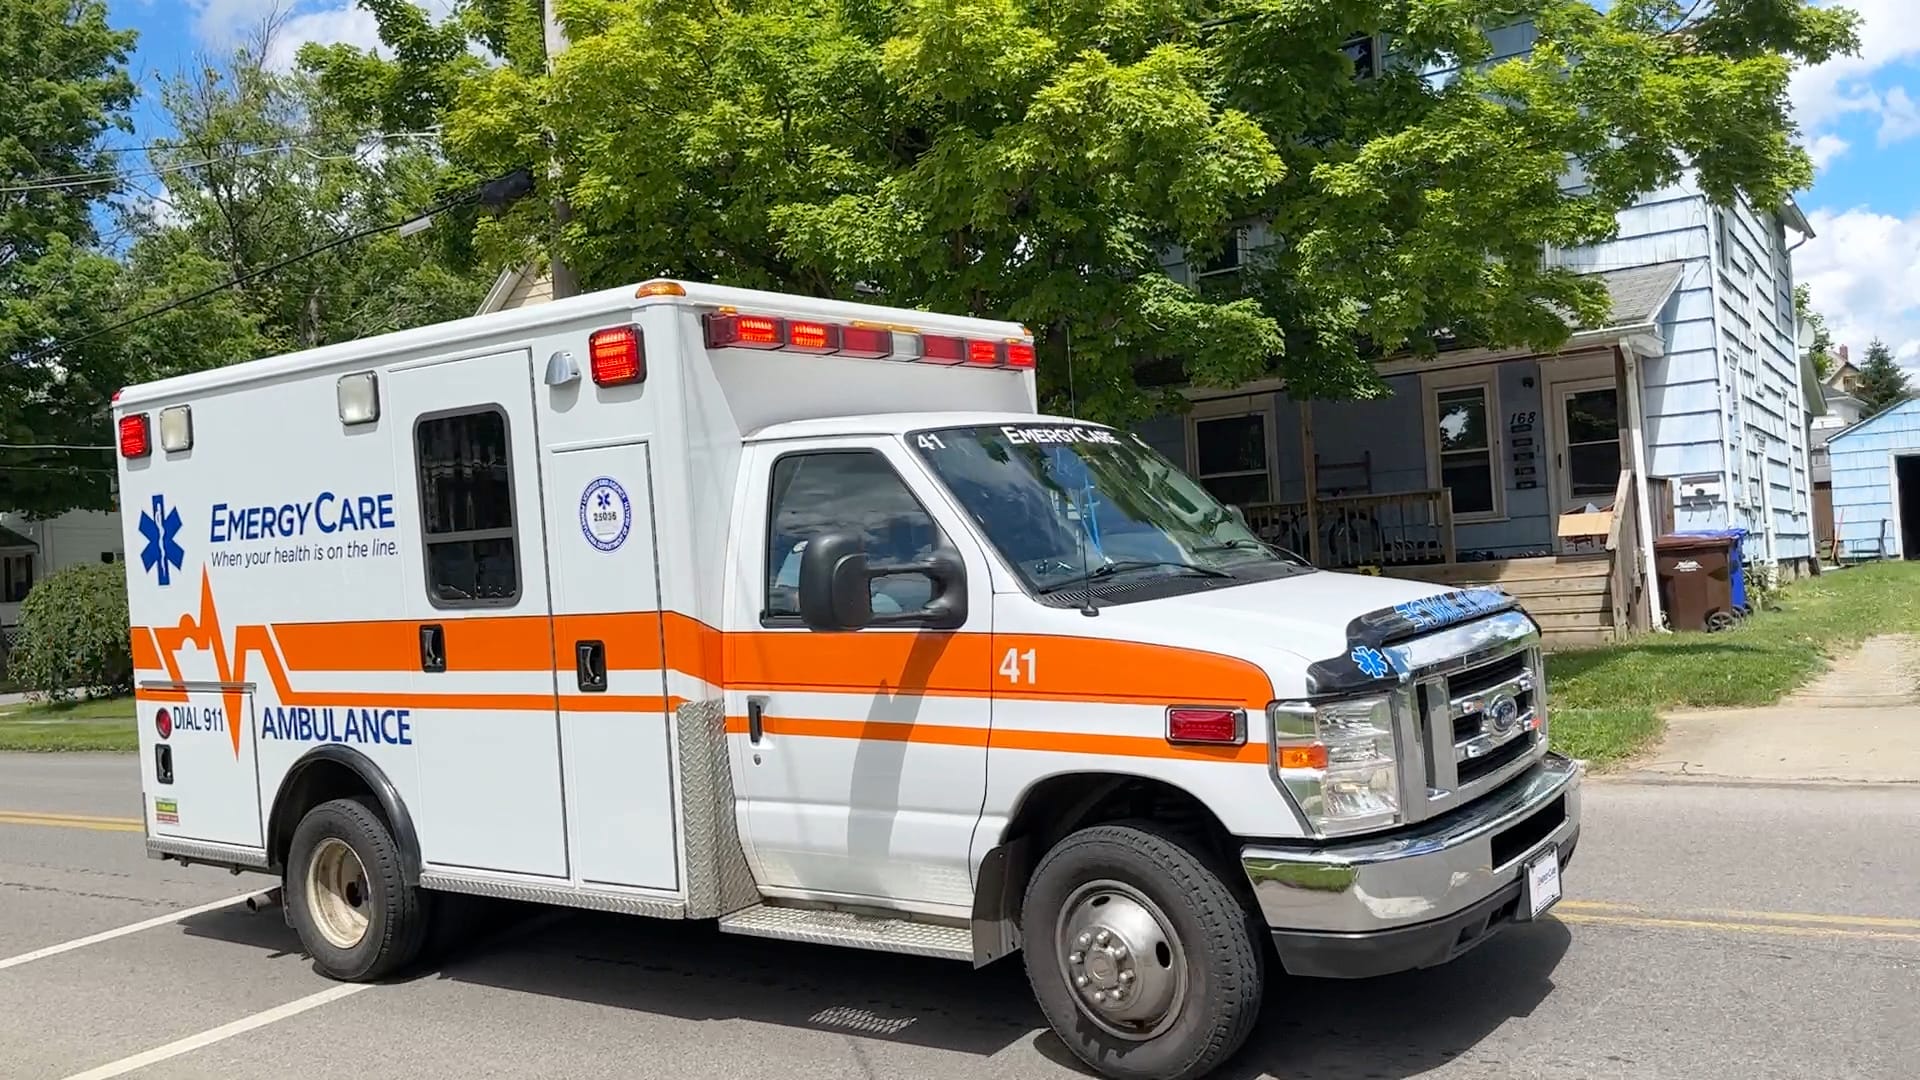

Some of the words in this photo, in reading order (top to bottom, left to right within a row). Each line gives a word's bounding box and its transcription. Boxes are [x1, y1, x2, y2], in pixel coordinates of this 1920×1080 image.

[1510, 411, 1537, 425] 168
[917, 434, 947, 450] 41
[210, 491, 396, 543] EMERGYCARE
[211, 551, 242, 568] When
[244, 552, 272, 569] your
[274, 545, 311, 564] health
[313, 543, 324, 561] is
[327, 545, 343, 560] on
[347, 540, 369, 559] the
[372, 538, 399, 557] line.
[998, 647, 1036, 685] 41
[173, 706, 203, 731] DIAL
[203, 708, 224, 733] 911
[261, 706, 413, 745] AMBULANCE
